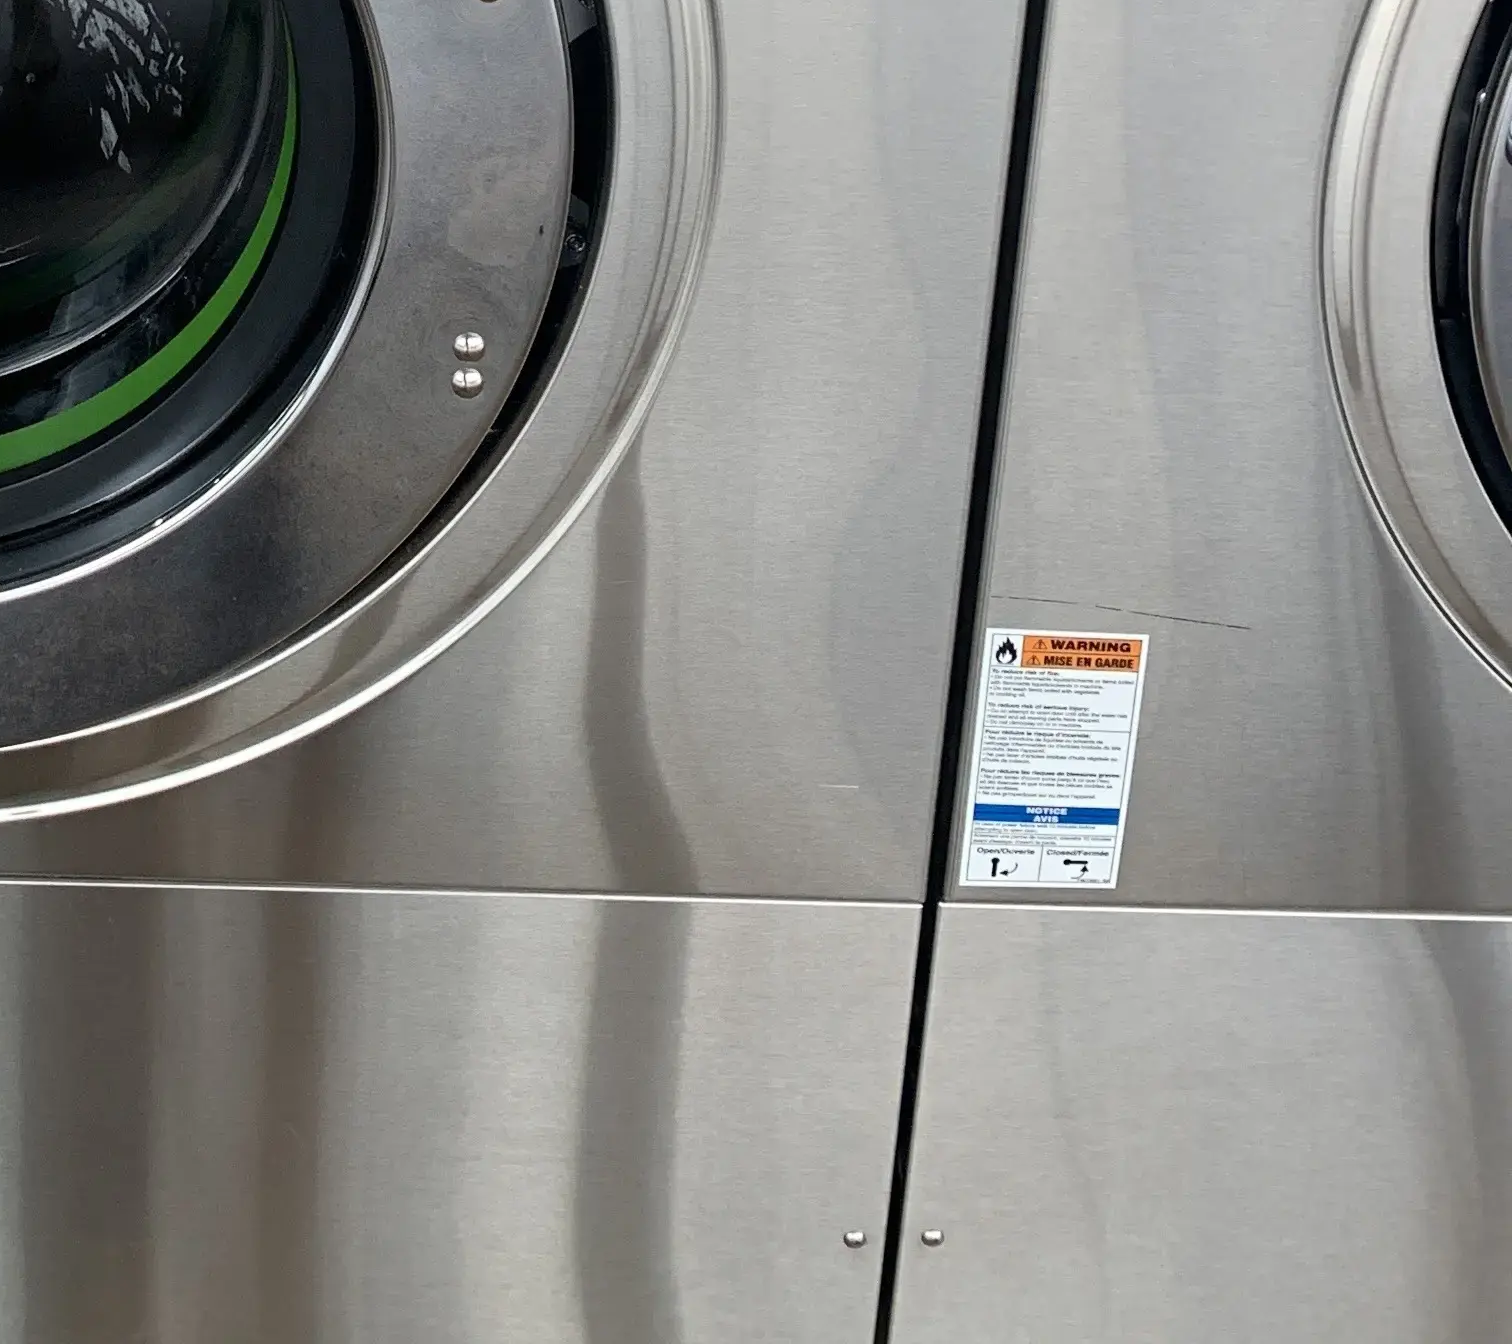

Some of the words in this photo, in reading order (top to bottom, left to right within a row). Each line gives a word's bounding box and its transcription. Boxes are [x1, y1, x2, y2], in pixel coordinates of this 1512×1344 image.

[1051, 639, 1131, 653] WARNING
[1043, 655, 1073, 667] MISE
[1076, 657, 1092, 667] EN
[1095, 657, 1135, 669] GARDE
[1025, 807, 1068, 816] NOTICE
[1033, 815, 1060, 823] AVIS
[976, 847, 1036, 856] Open/Ouverte
[1046, 848, 1110, 857] Closed/Fermée
